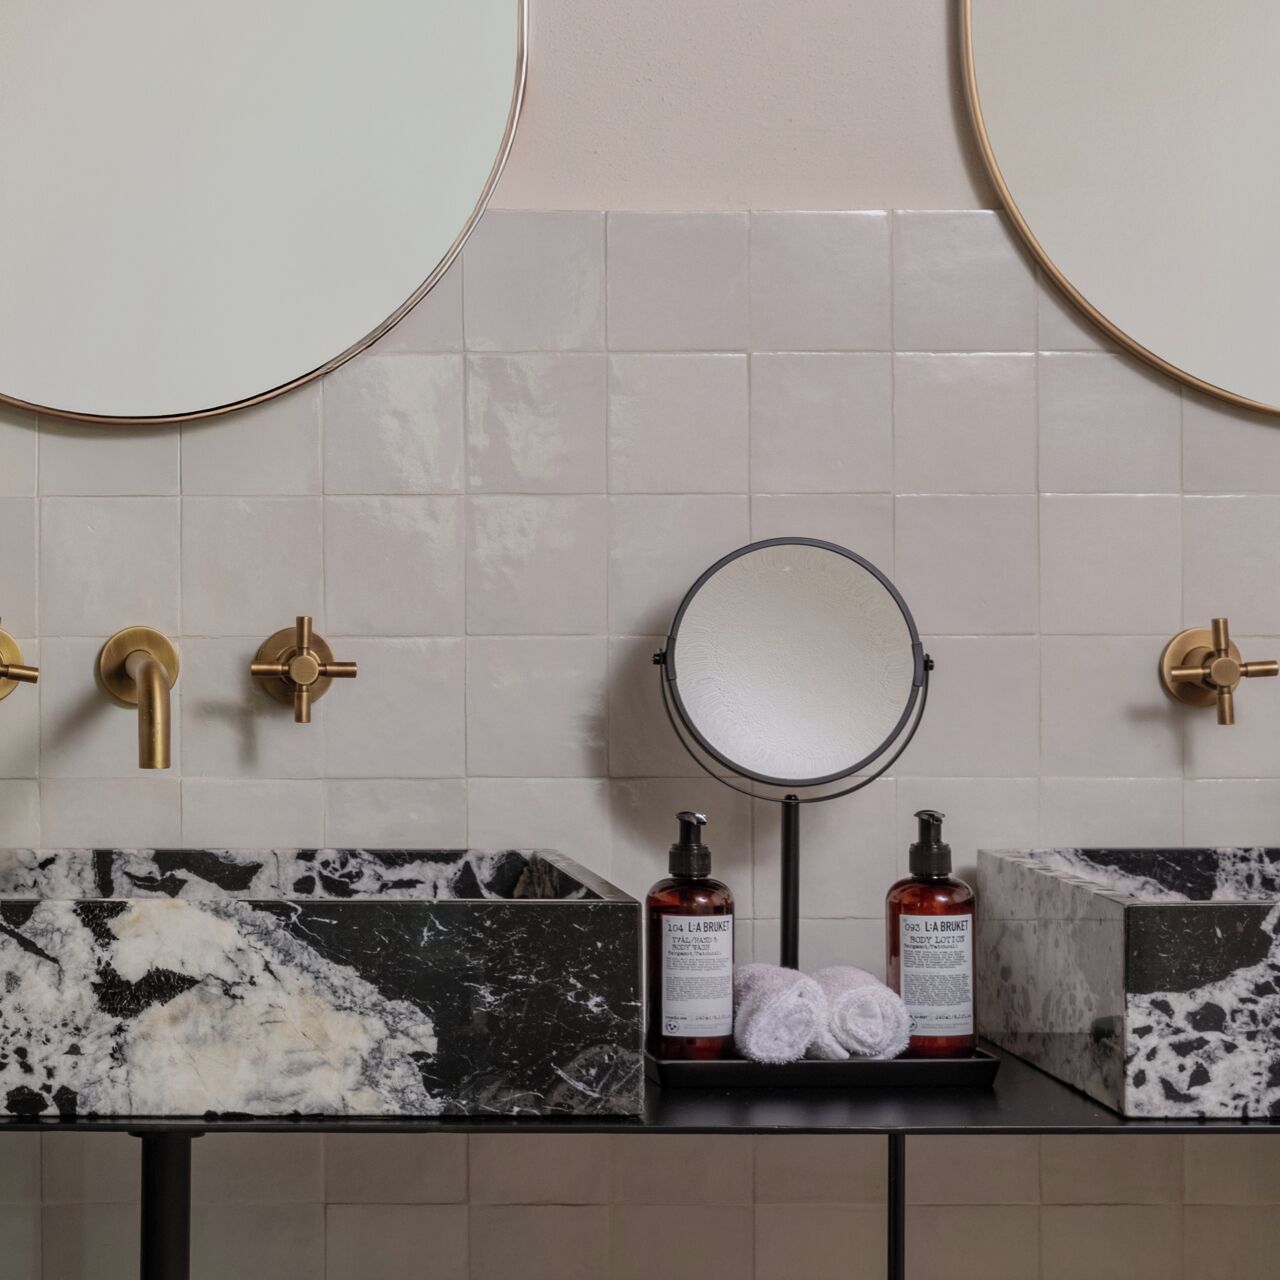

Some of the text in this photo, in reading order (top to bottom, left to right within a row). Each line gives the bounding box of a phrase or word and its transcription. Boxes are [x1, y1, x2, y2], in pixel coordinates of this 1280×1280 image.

[667, 920, 730, 933] 104 L:A BRUKET
[904, 919, 969, 932] 093 L:A BRUKET
[909, 934, 966, 944] BODY LOTION
